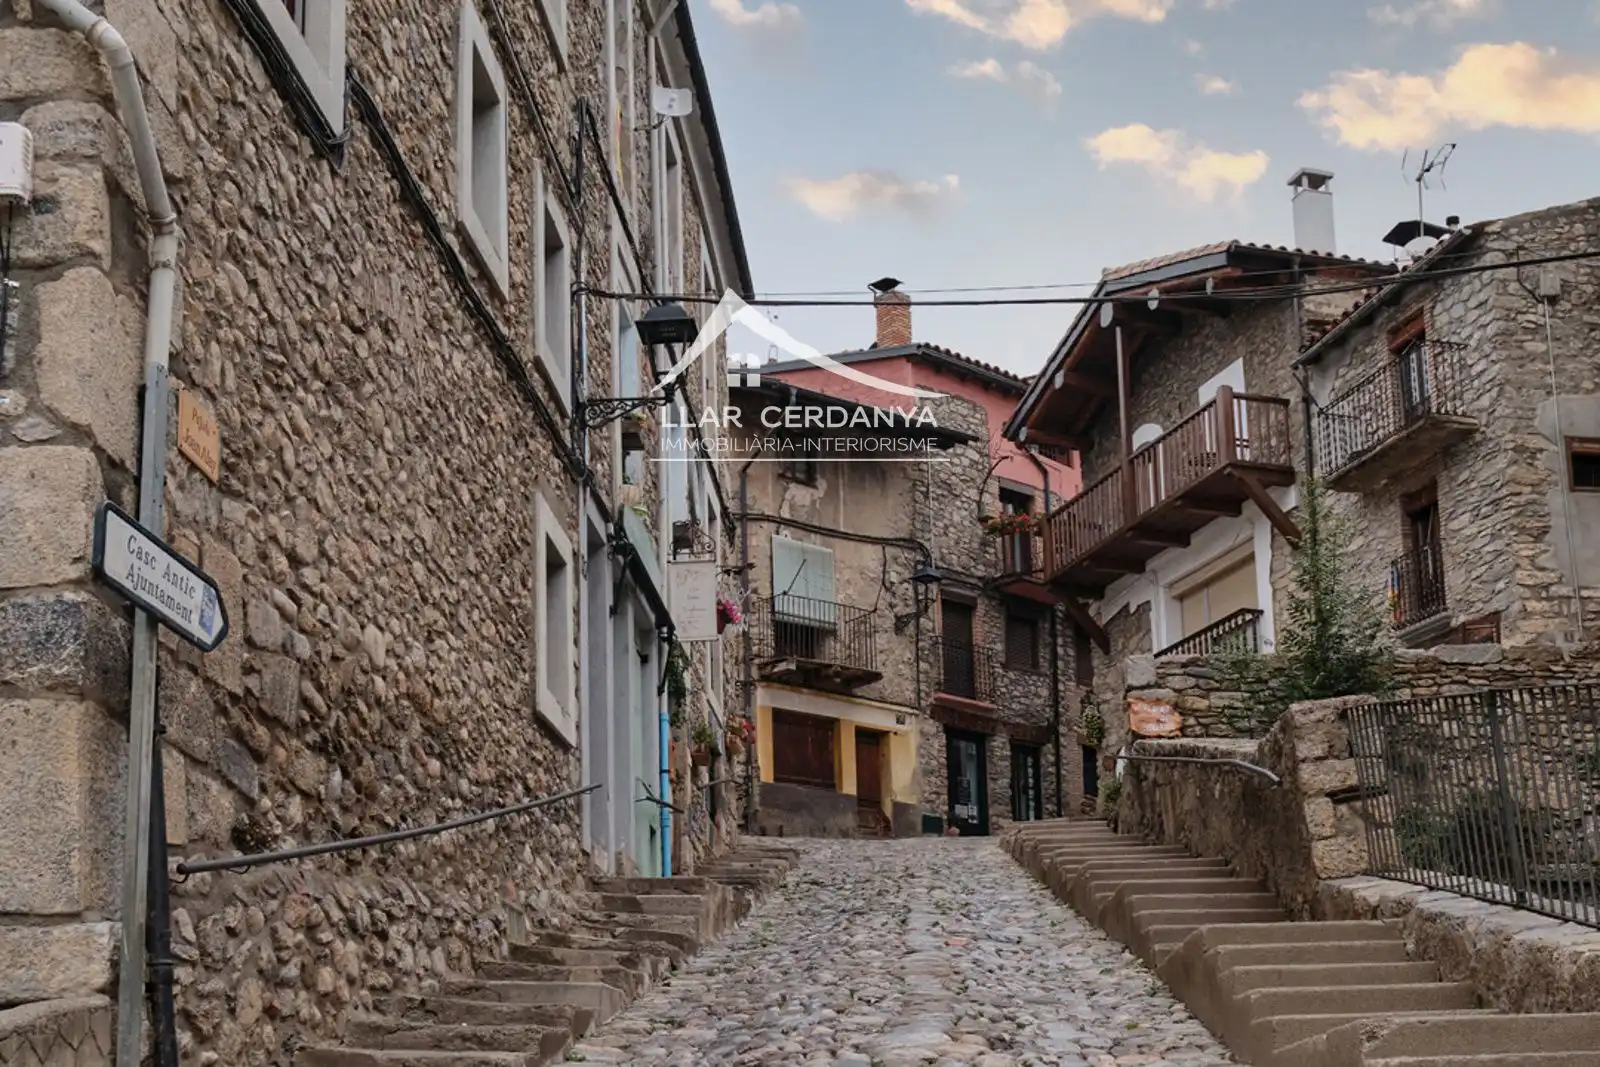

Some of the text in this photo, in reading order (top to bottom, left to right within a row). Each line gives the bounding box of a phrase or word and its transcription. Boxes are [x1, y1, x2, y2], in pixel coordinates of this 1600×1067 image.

[125, 563, 194, 625] Ajuntament
[127, 534, 197, 600] Casc Antic
